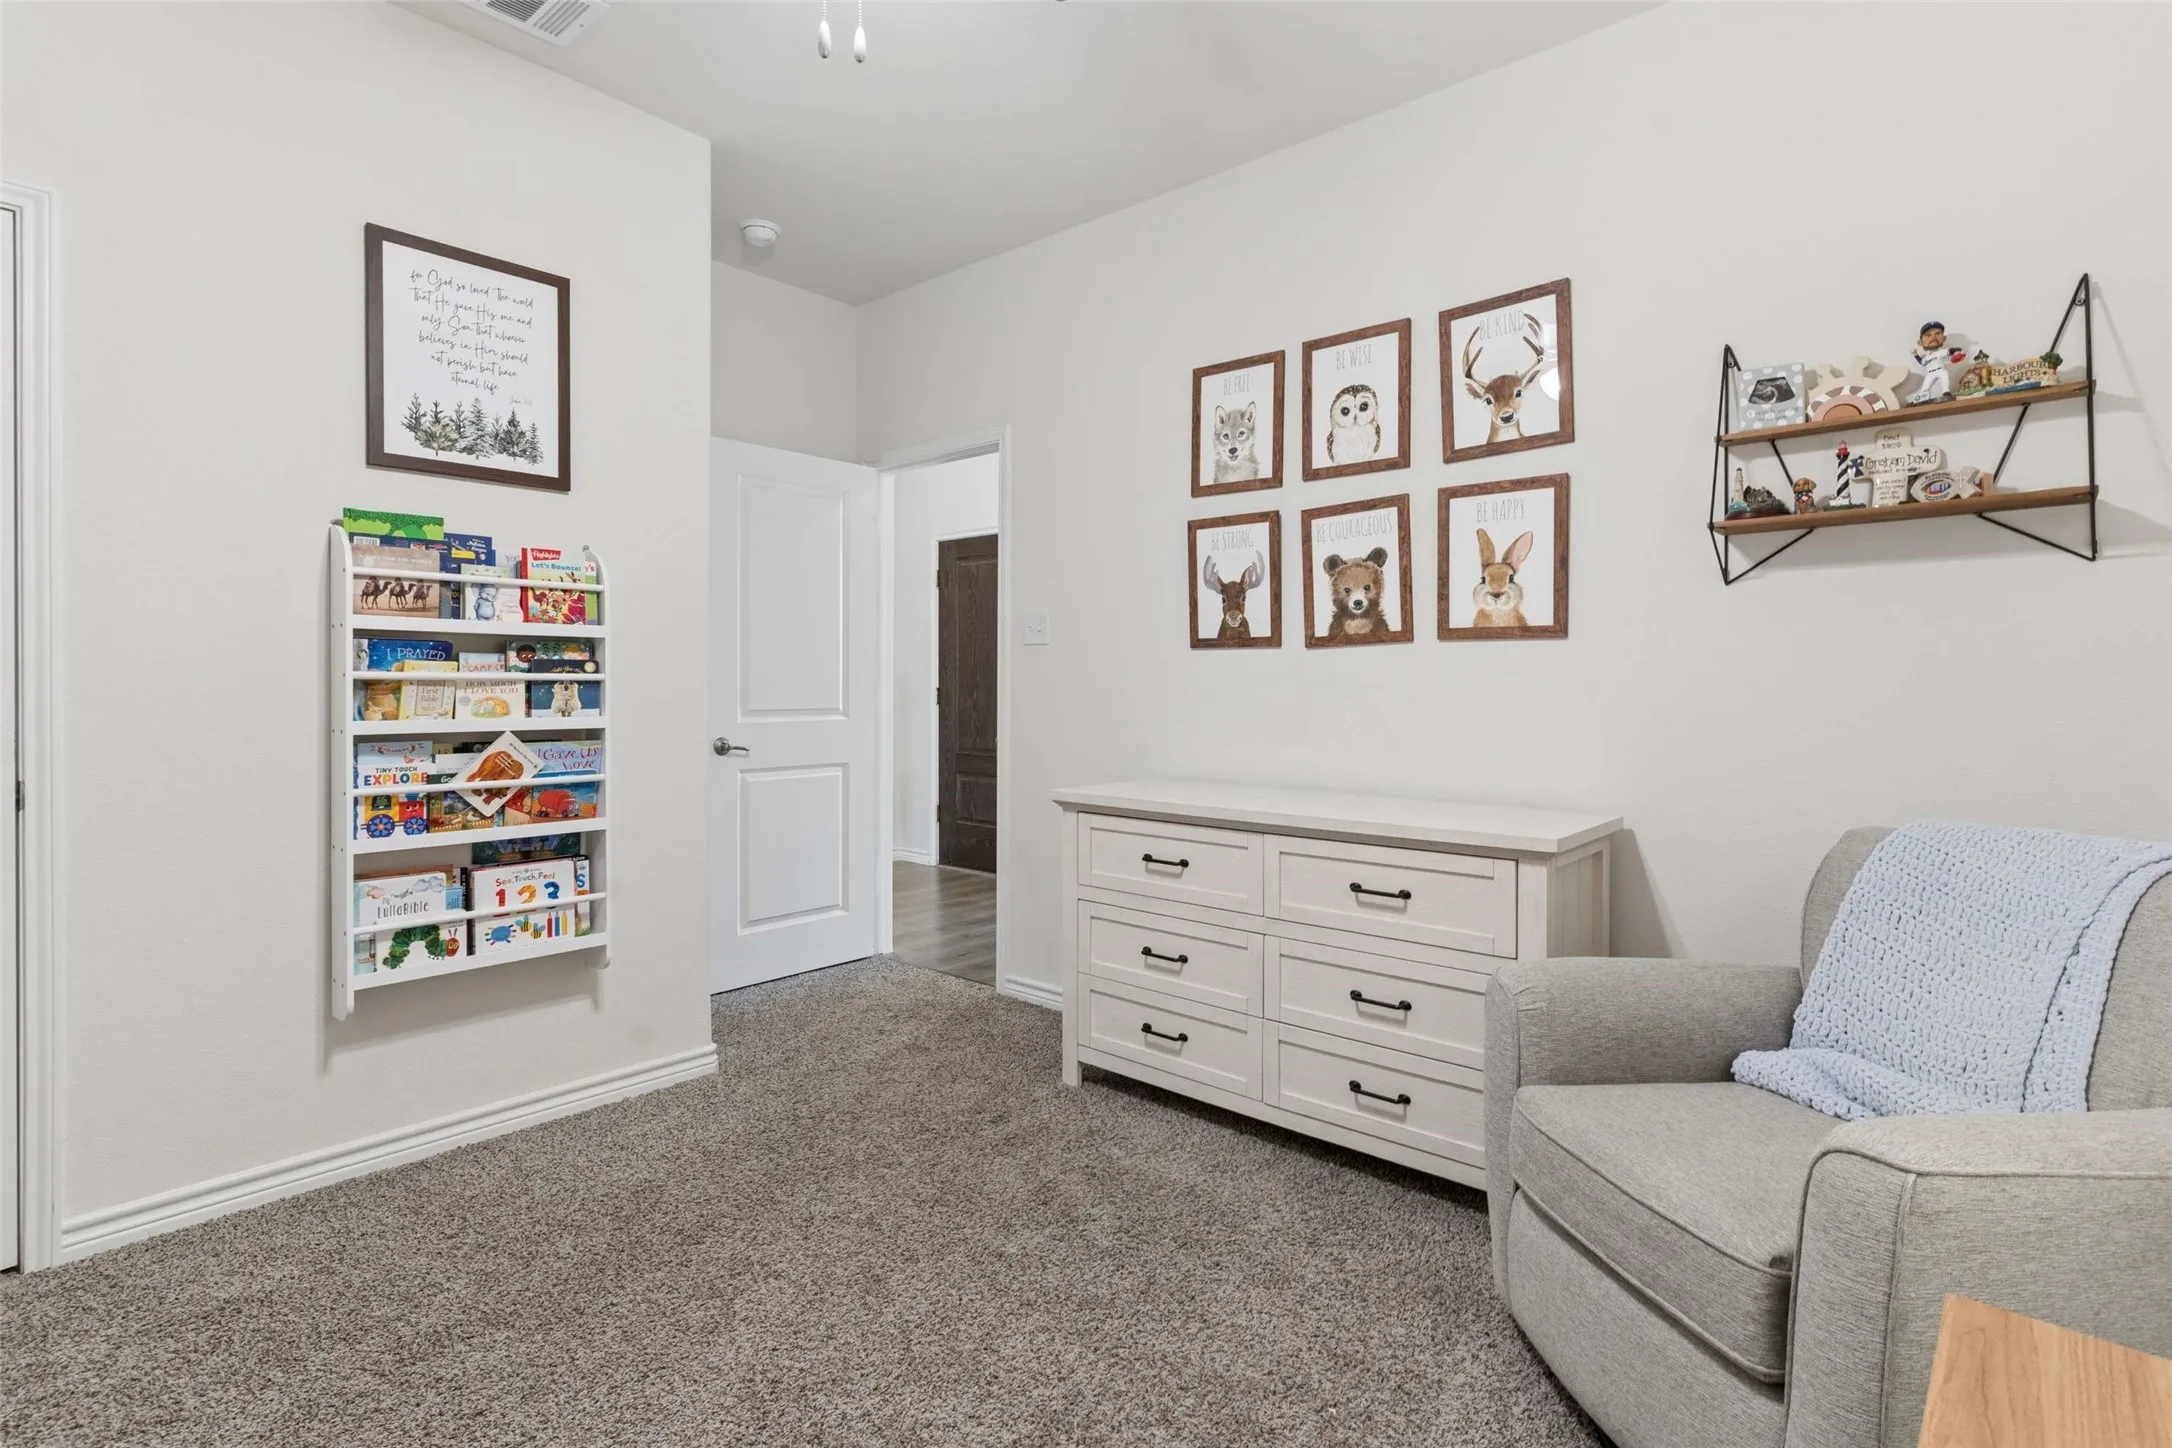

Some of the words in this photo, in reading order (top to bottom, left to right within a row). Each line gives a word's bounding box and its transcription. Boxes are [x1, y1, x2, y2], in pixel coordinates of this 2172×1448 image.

[427, 269, 454, 292] God
[456, 283, 466, 292] so
[469, 283, 490, 298] loved
[512, 297, 534, 309] world
[434, 291, 451, 312] He
[453, 302, 474, 314] gave
[475, 302, 497, 323] His
[500, 314, 514, 322] one
[516, 317, 532, 329] and
[421, 313, 444, 331] only
[447, 314, 472, 336] Son
[495, 331, 526, 344] whoever
[1480, 318, 1491, 340] BE
[1495, 311, 1524, 336] KIND
[418, 330, 457, 350] believes
[460, 340, 472, 351] in
[474, 339, 498, 360] Him
[500, 349, 529, 365] should
[1336, 350, 1347, 371] BE
[1350, 344, 1372, 368] WISE
[431, 350, 448, 366] not
[447, 358, 477, 371] perish
[480, 361, 499, 376] but
[498, 366, 518, 377] have
[1992, 360, 2048, 376] HARBOUR
[450, 371, 479, 388] eternal
[483, 379, 499, 396] life
[1224, 377, 1231, 396] BE
[1234, 373, 1250, 392] FREE
[2003, 369, 2040, 384] LIGHTS
[1865, 457, 1905, 469] Graham
[1906, 450, 1938, 465] David
[1476, 501, 1488, 523] BE
[1492, 498, 1525, 521] HAPPY
[1316, 523, 1327, 543] BE
[1329, 513, 1393, 541] COURAGEOUS
[1212, 533, 1220, 551] BE
[1223, 529, 1253, 551] STRONG
[532, 550, 560, 559] Highlights
[551, 563, 581, 572] Bounce!
[386, 648, 392, 660] I
[397, 647, 446, 661] PRAYED
[468, 664, 491, 672] CAMP
[421, 694, 439, 702] Bible
[543, 748, 577, 760] Gave
[562, 760, 595, 770] Love
[363, 771, 428, 786] EXPLORE
[538, 872, 556, 880] Feel
[494, 888, 508, 911] 1
[517, 884, 537, 907] 2
[377, 901, 429, 919] LullaBible
